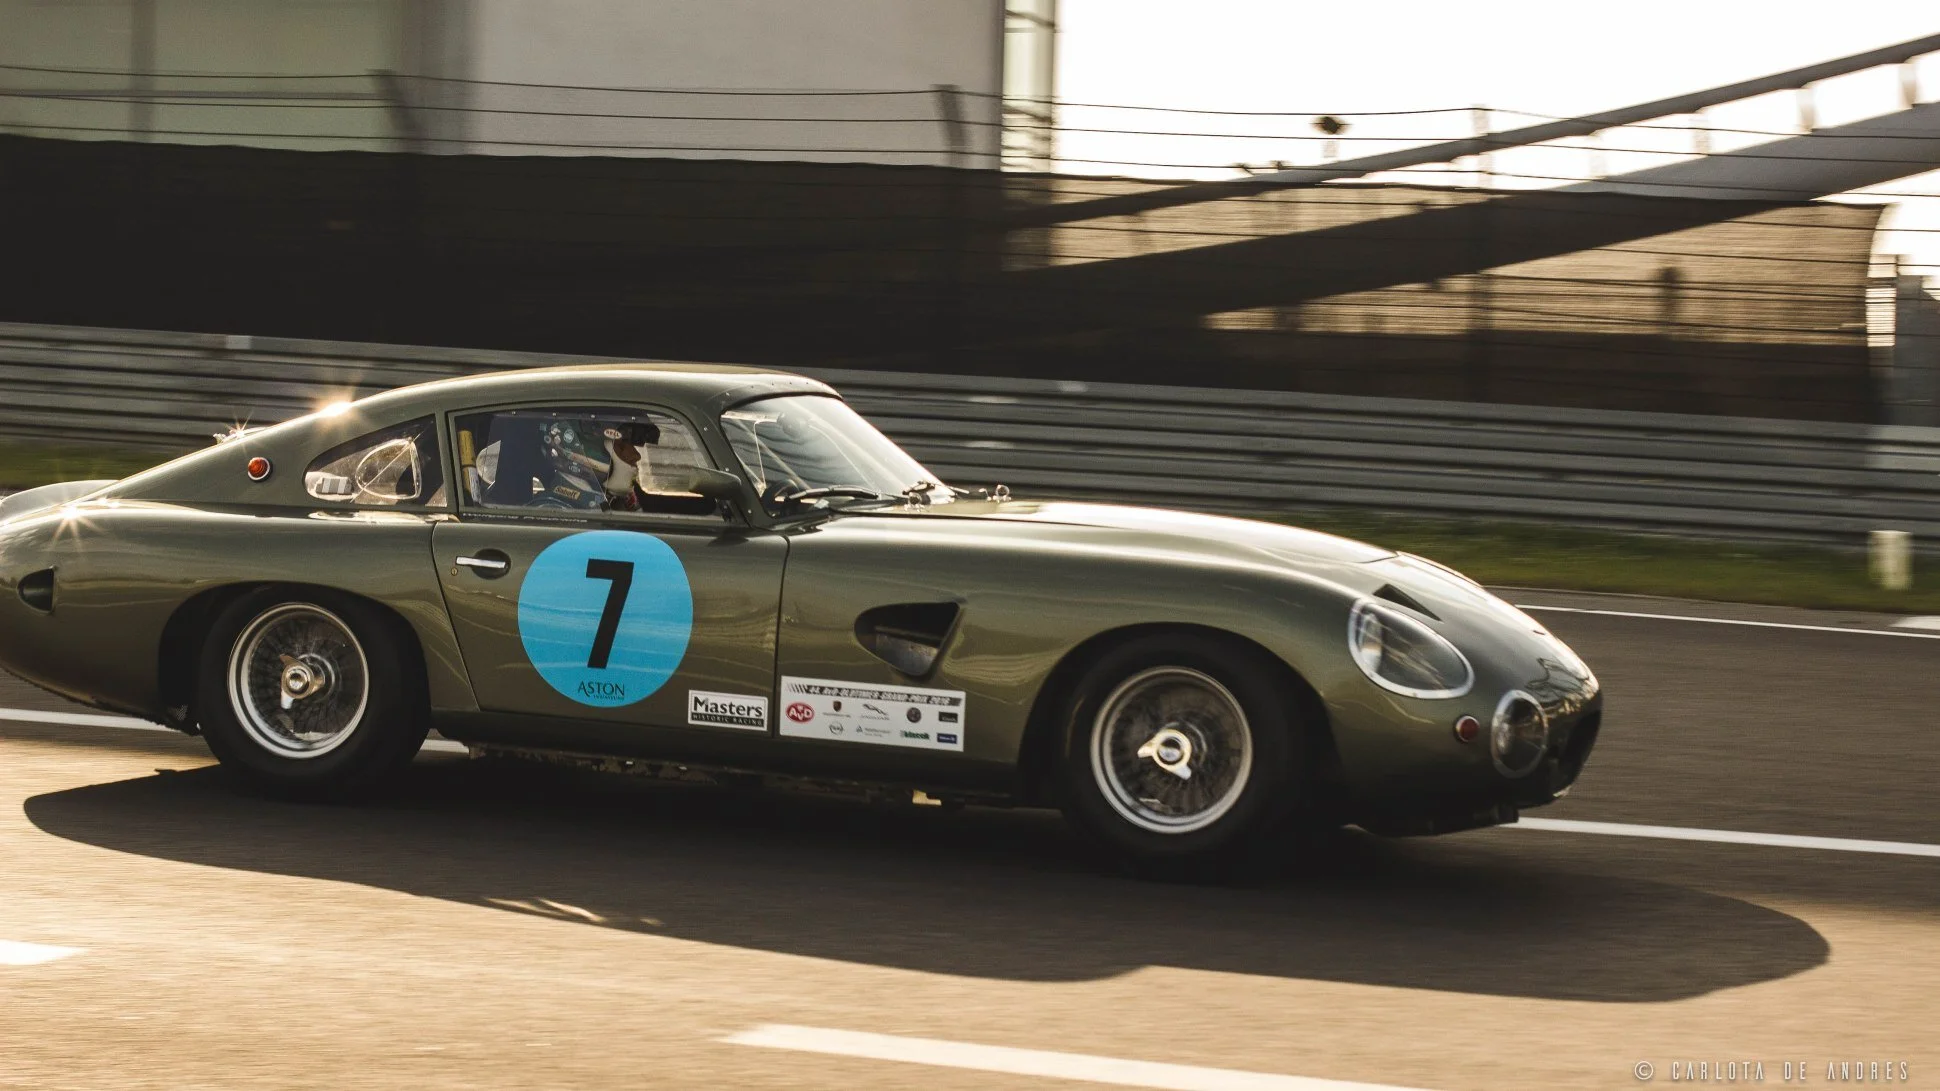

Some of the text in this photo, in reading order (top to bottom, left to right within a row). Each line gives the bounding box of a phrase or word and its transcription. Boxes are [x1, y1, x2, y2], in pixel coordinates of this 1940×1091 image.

[585, 557, 635, 669] 7
[577, 680, 625, 697] ASTON
[693, 696, 763, 718] Masters
[692, 713, 763, 726] HISTORIC RACING
